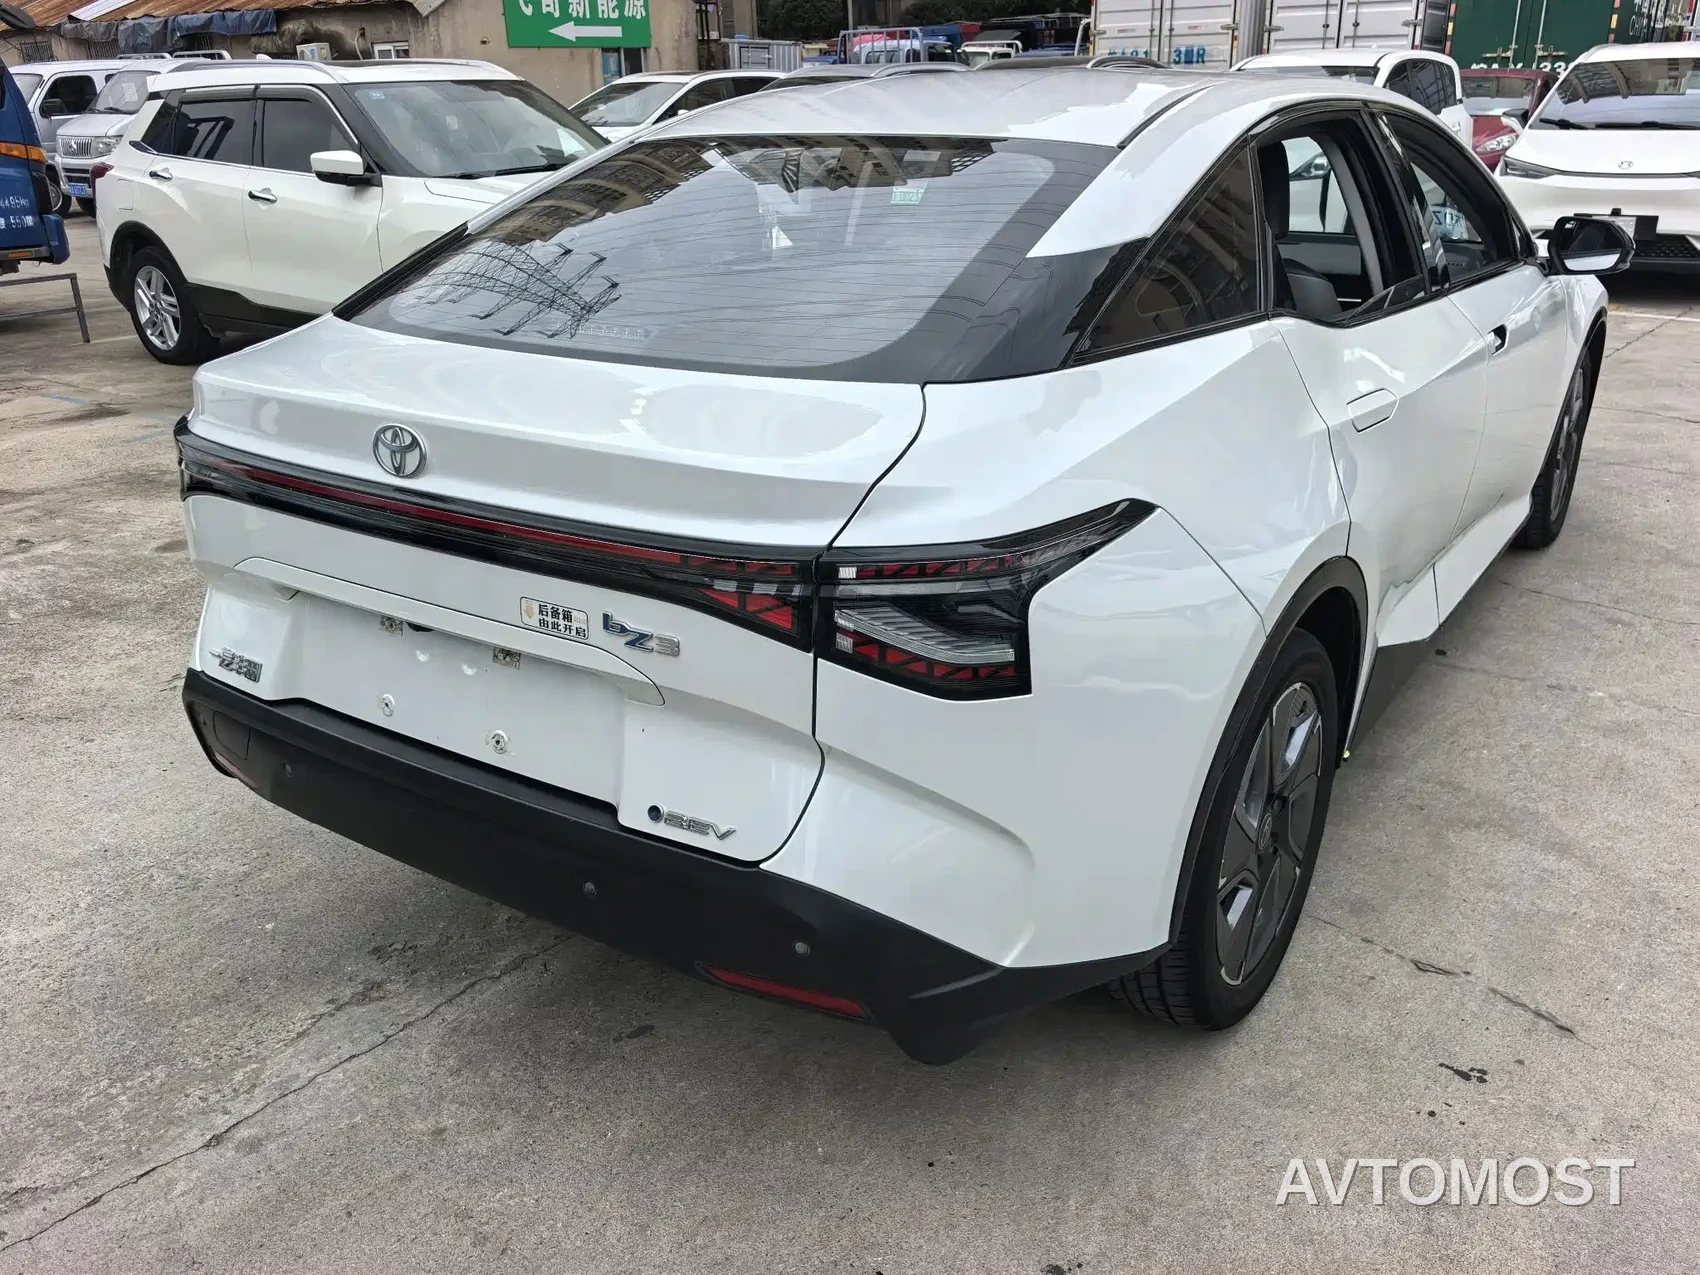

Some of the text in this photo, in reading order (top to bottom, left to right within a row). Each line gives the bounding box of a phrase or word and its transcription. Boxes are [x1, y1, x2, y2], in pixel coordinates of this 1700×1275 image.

[538, 603, 573, 624] 后备箱
[538, 618, 587, 638] 由此开启
